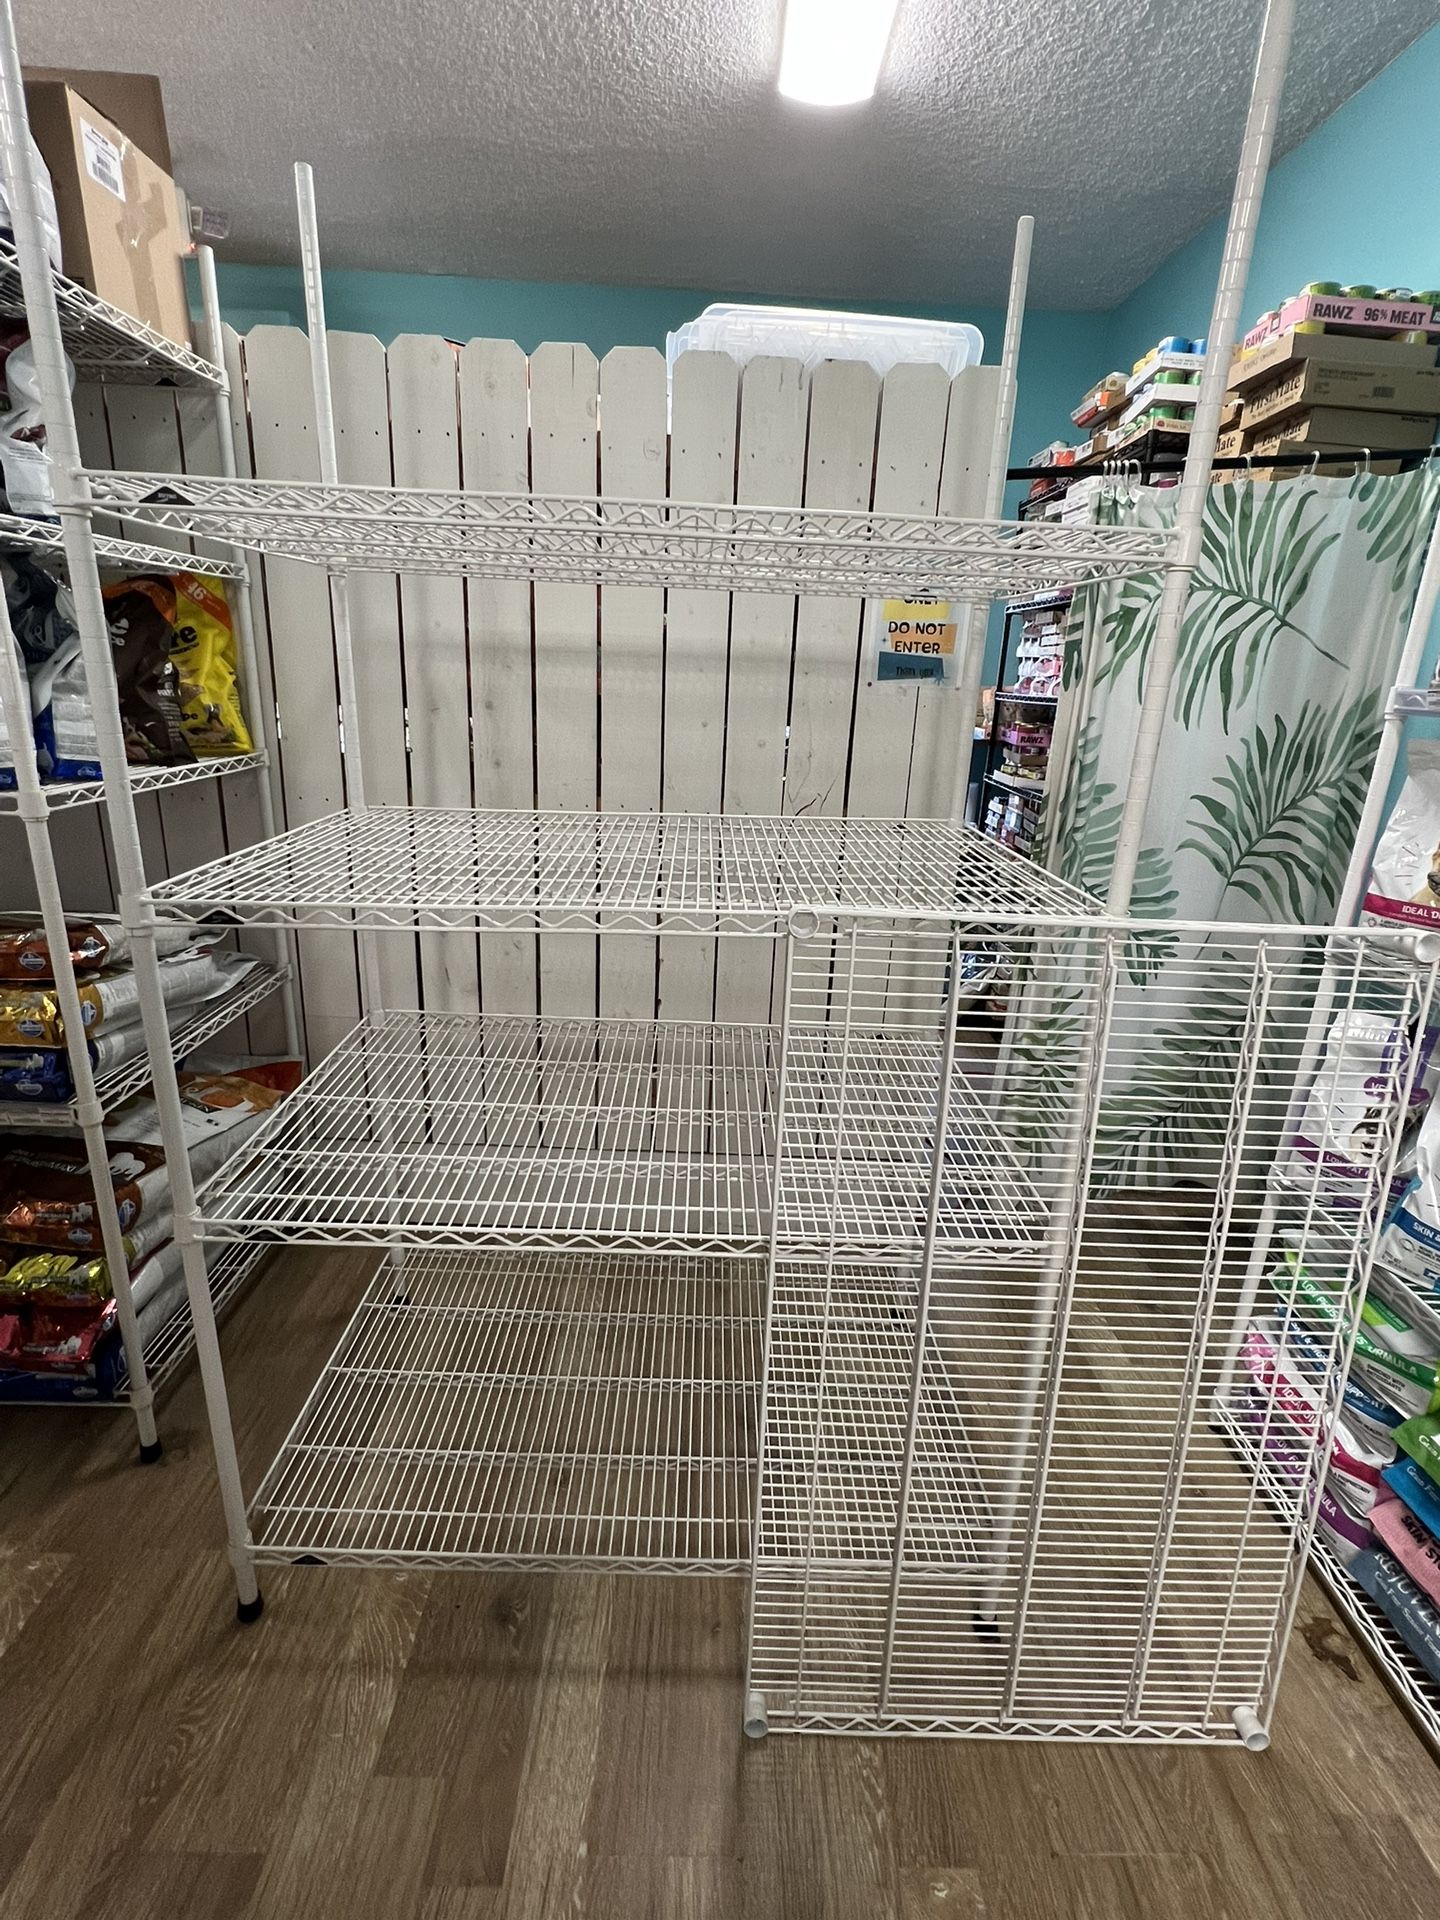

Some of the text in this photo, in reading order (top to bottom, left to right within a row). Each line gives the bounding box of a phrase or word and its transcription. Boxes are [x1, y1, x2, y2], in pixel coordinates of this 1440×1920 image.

[1313, 303, 1355, 320] RAWZ
[1390, 309, 1426, 326] MEAT
[888, 621, 946, 635] DO NOT
[1402, 905, 1429, 918] IDEAL
[1413, 1221, 1434, 1239] SKIN
